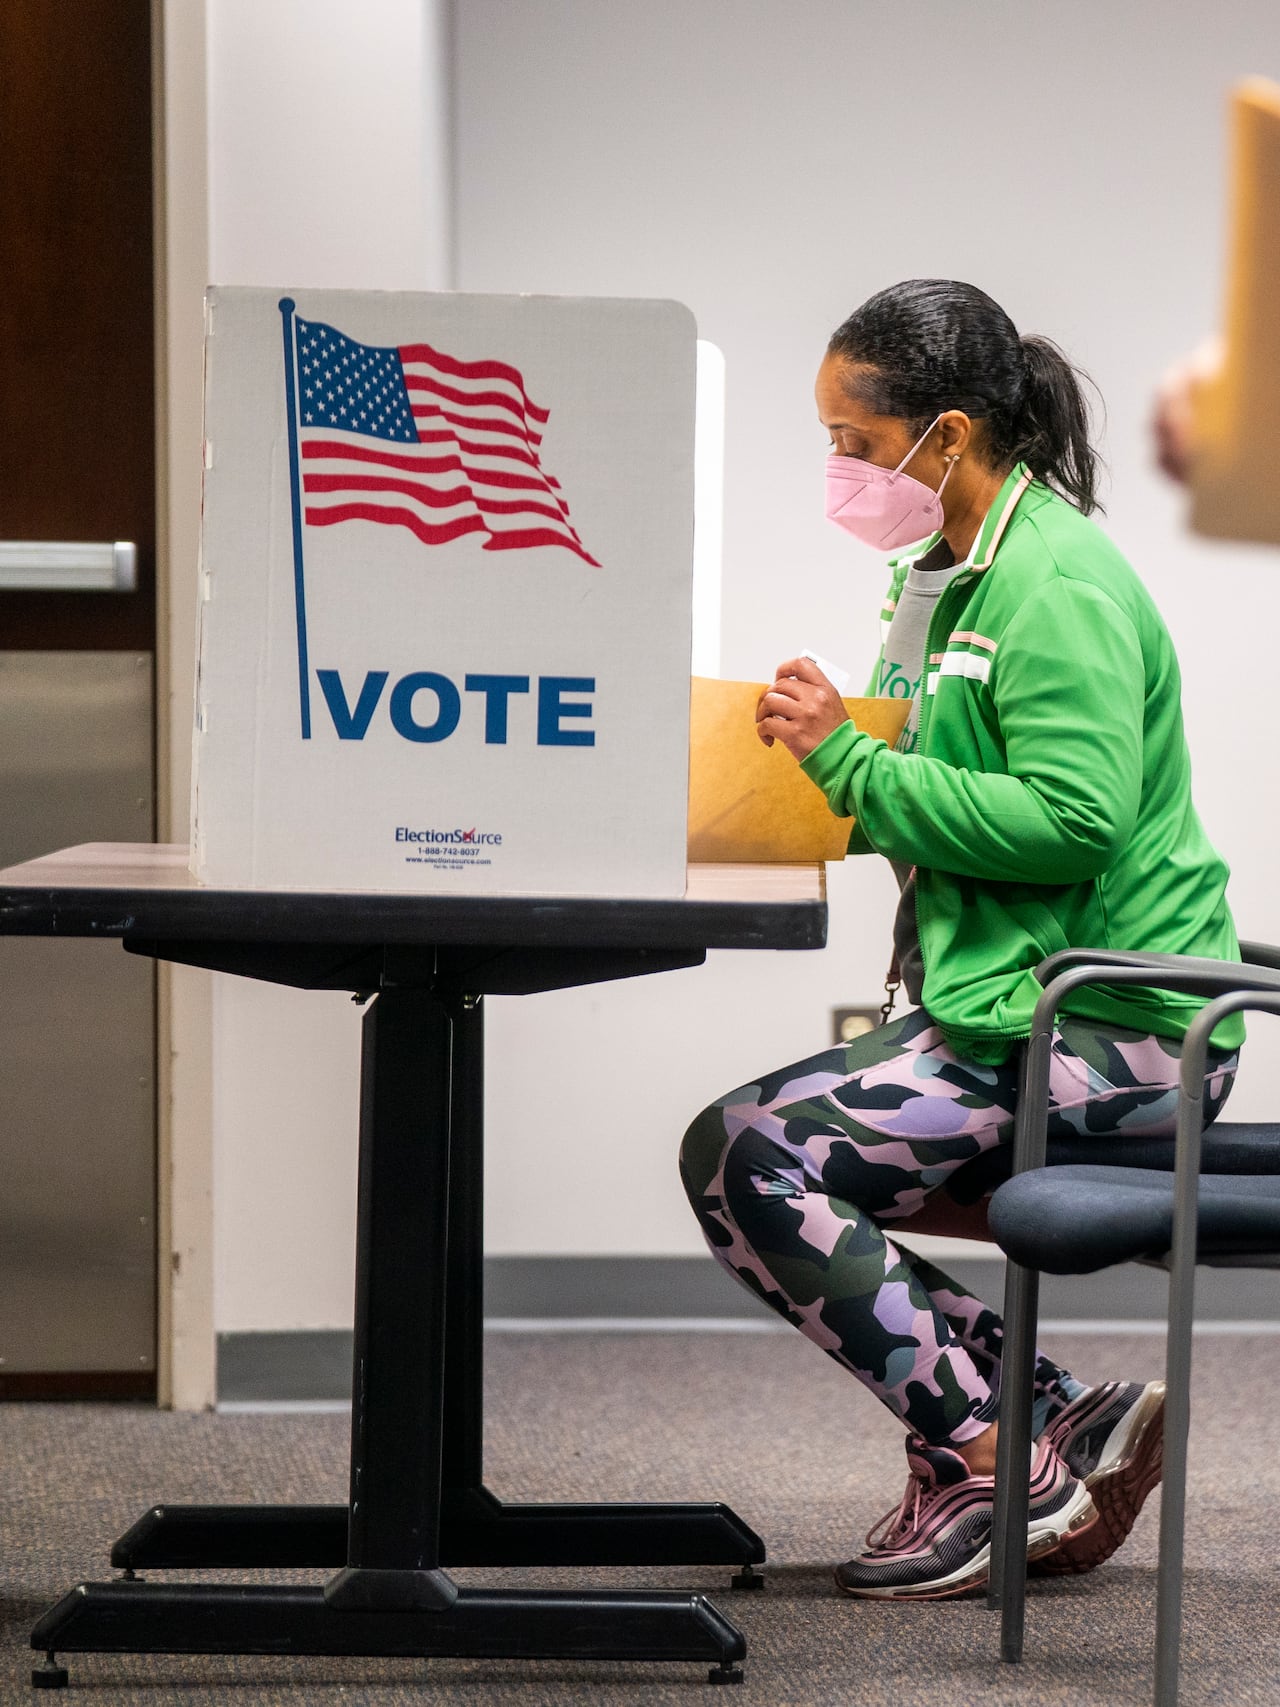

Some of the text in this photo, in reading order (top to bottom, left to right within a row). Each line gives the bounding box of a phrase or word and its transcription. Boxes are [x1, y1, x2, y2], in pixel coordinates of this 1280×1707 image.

[316, 669, 595, 747] VOTE
[395, 827, 502, 844] ElectionSource
[418, 847, 480, 856] 1-888-742-8037
